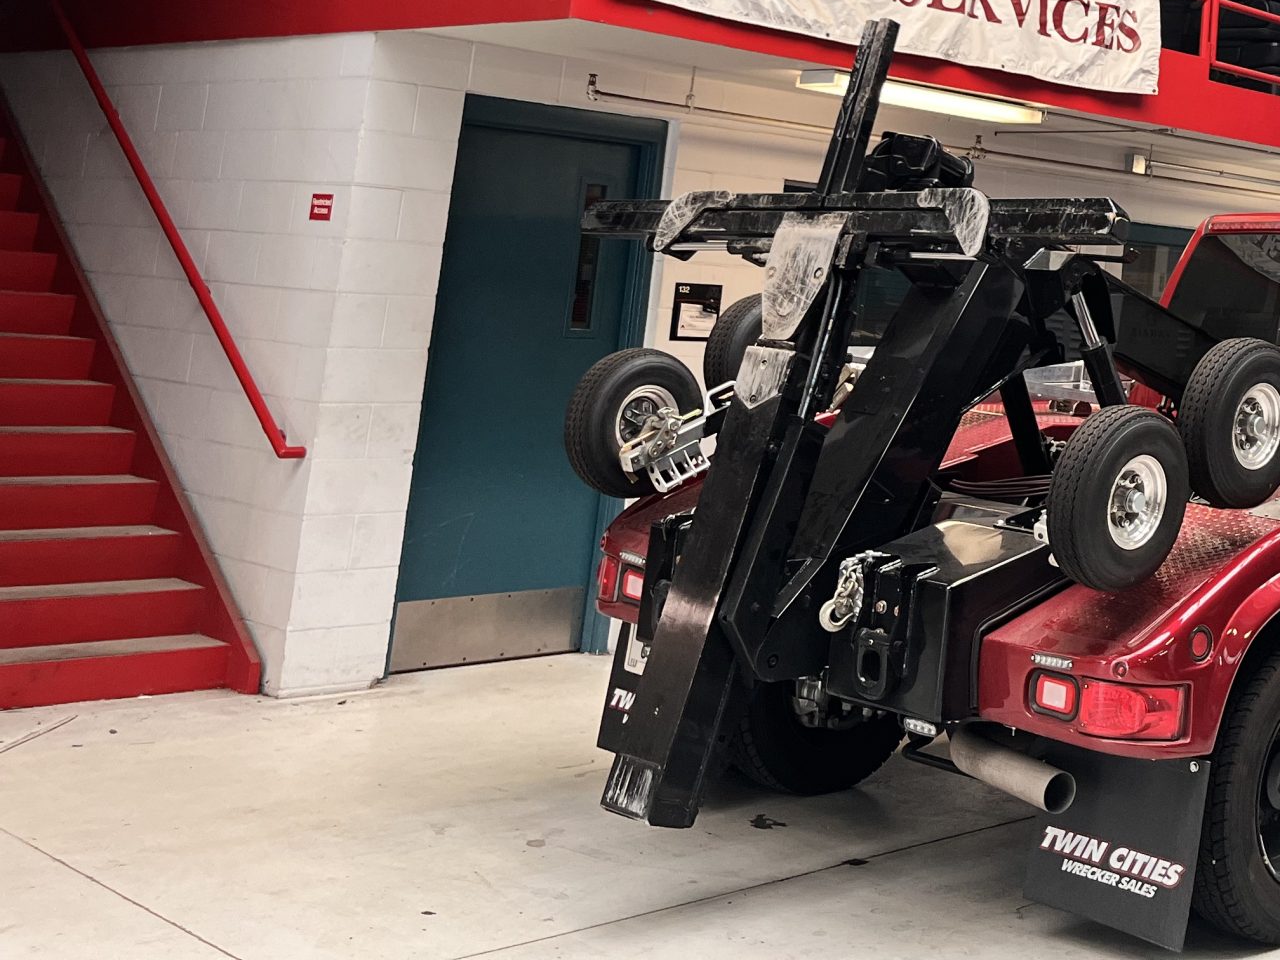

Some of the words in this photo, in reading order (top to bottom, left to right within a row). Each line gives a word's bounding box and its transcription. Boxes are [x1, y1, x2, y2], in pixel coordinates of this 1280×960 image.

[679, 285, 690, 294] 132
[1041, 825, 1109, 863] TWIN
[1109, 847, 1184, 886] CITIES
[1061, 859, 1119, 887] WRECKER
[1118, 876, 1157, 898] SALES
